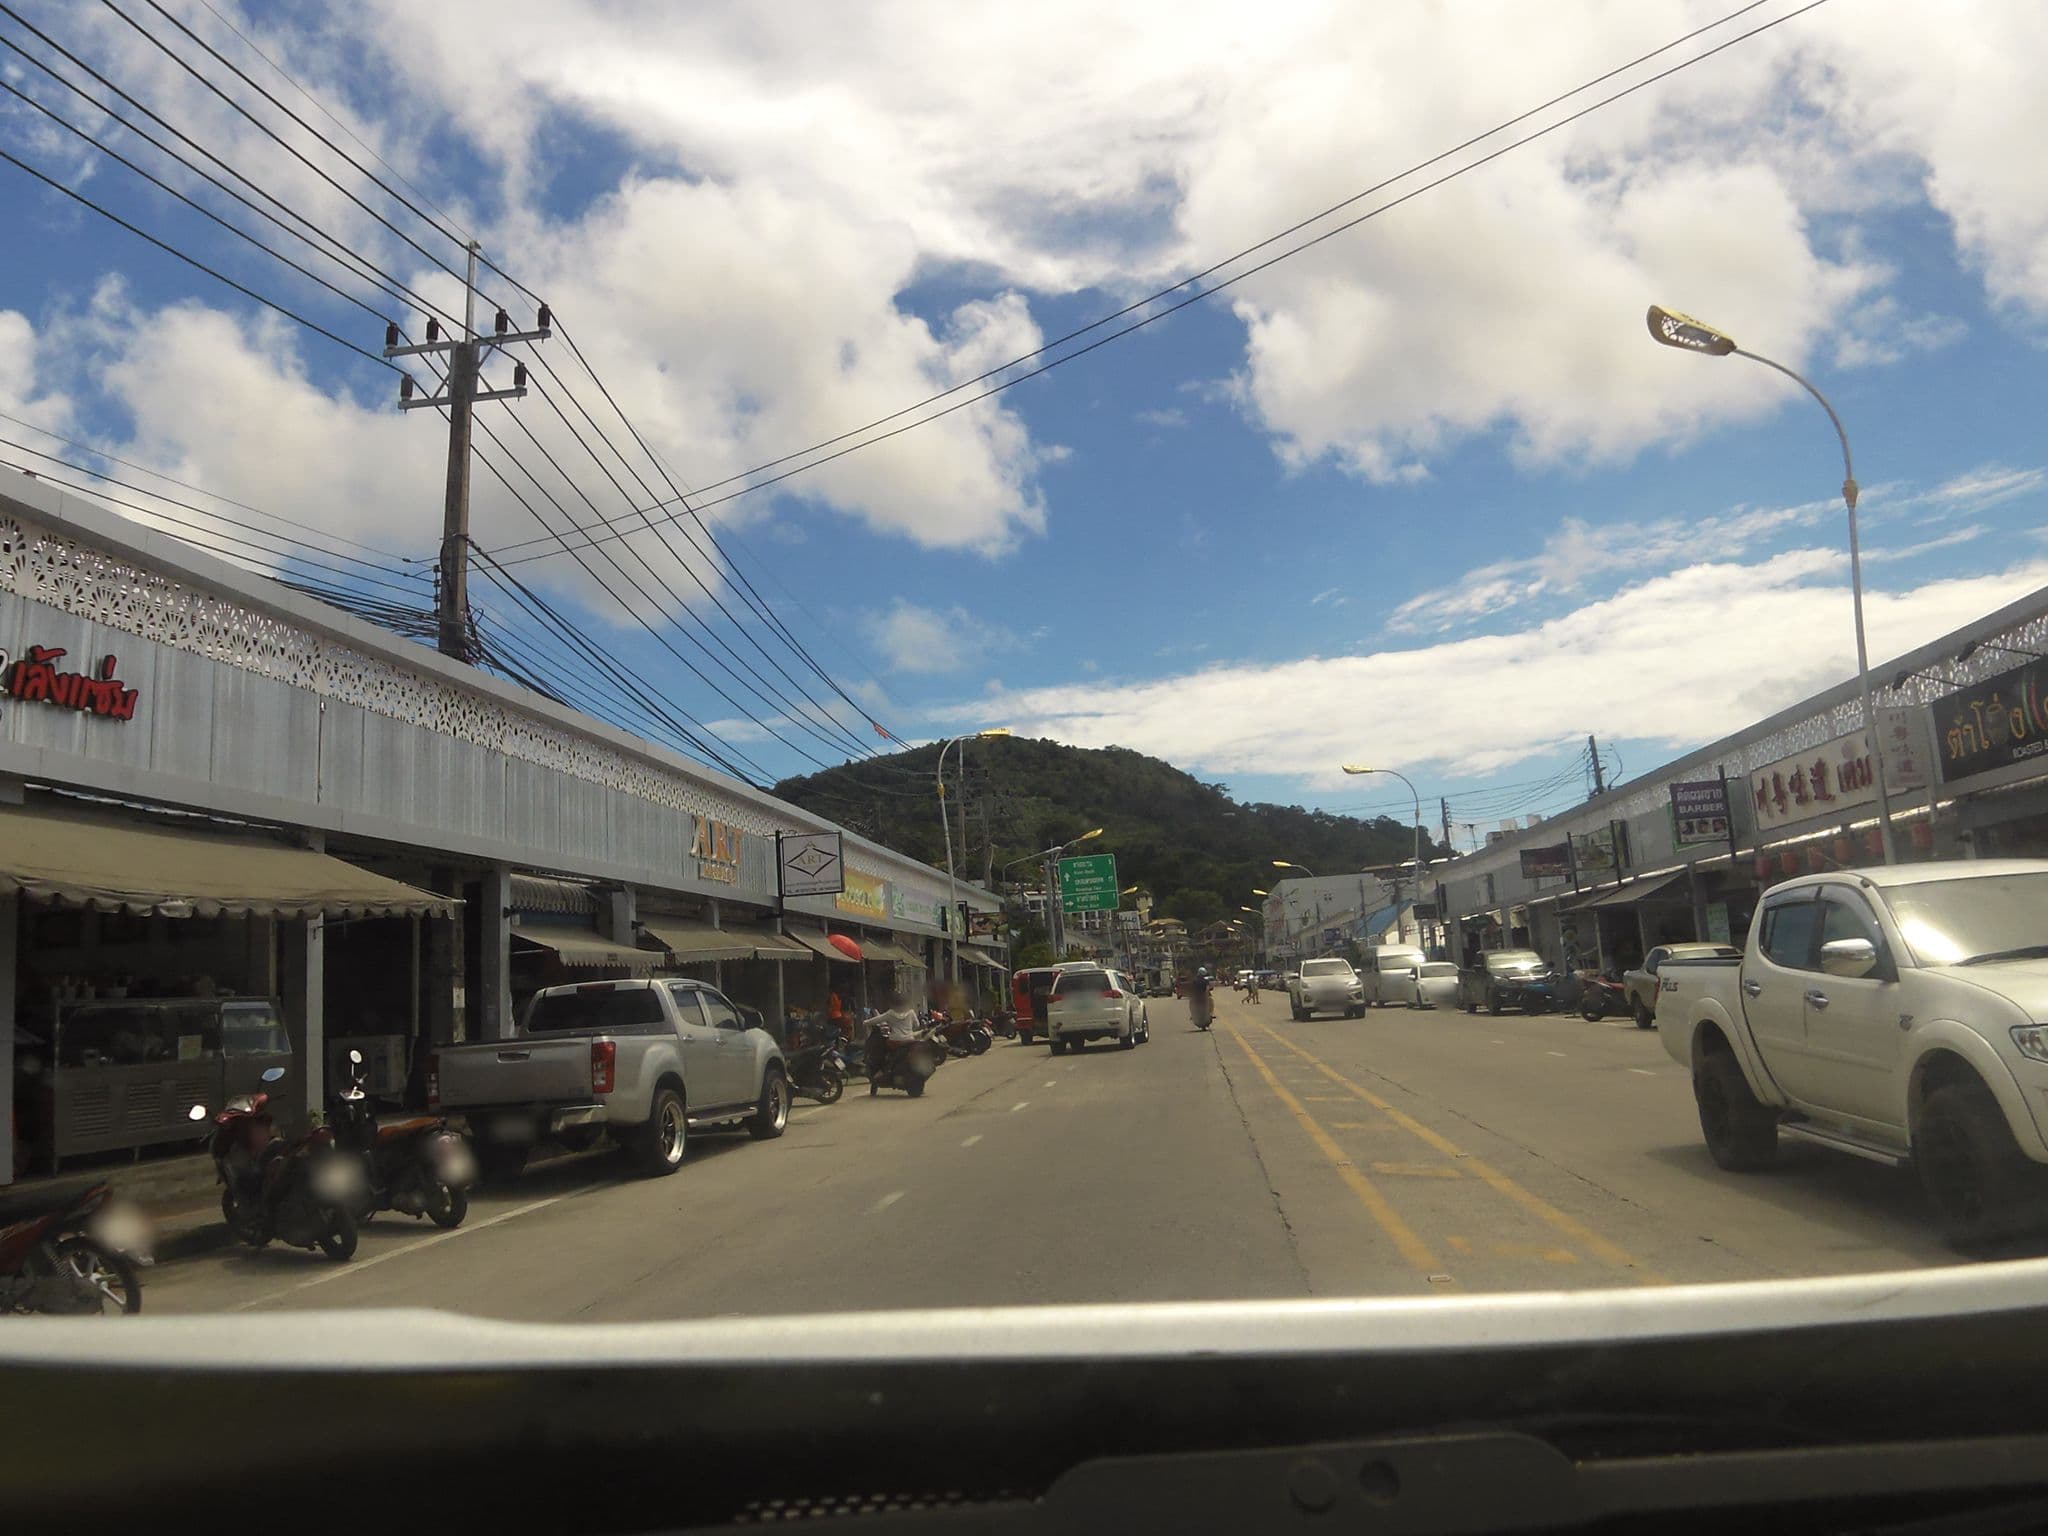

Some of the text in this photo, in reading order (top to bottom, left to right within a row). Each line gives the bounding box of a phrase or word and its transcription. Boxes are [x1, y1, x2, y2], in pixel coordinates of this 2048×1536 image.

[1678, 802, 1724, 814] BARBER
[689, 815, 744, 866] ART
[797, 853, 824, 867] ART
